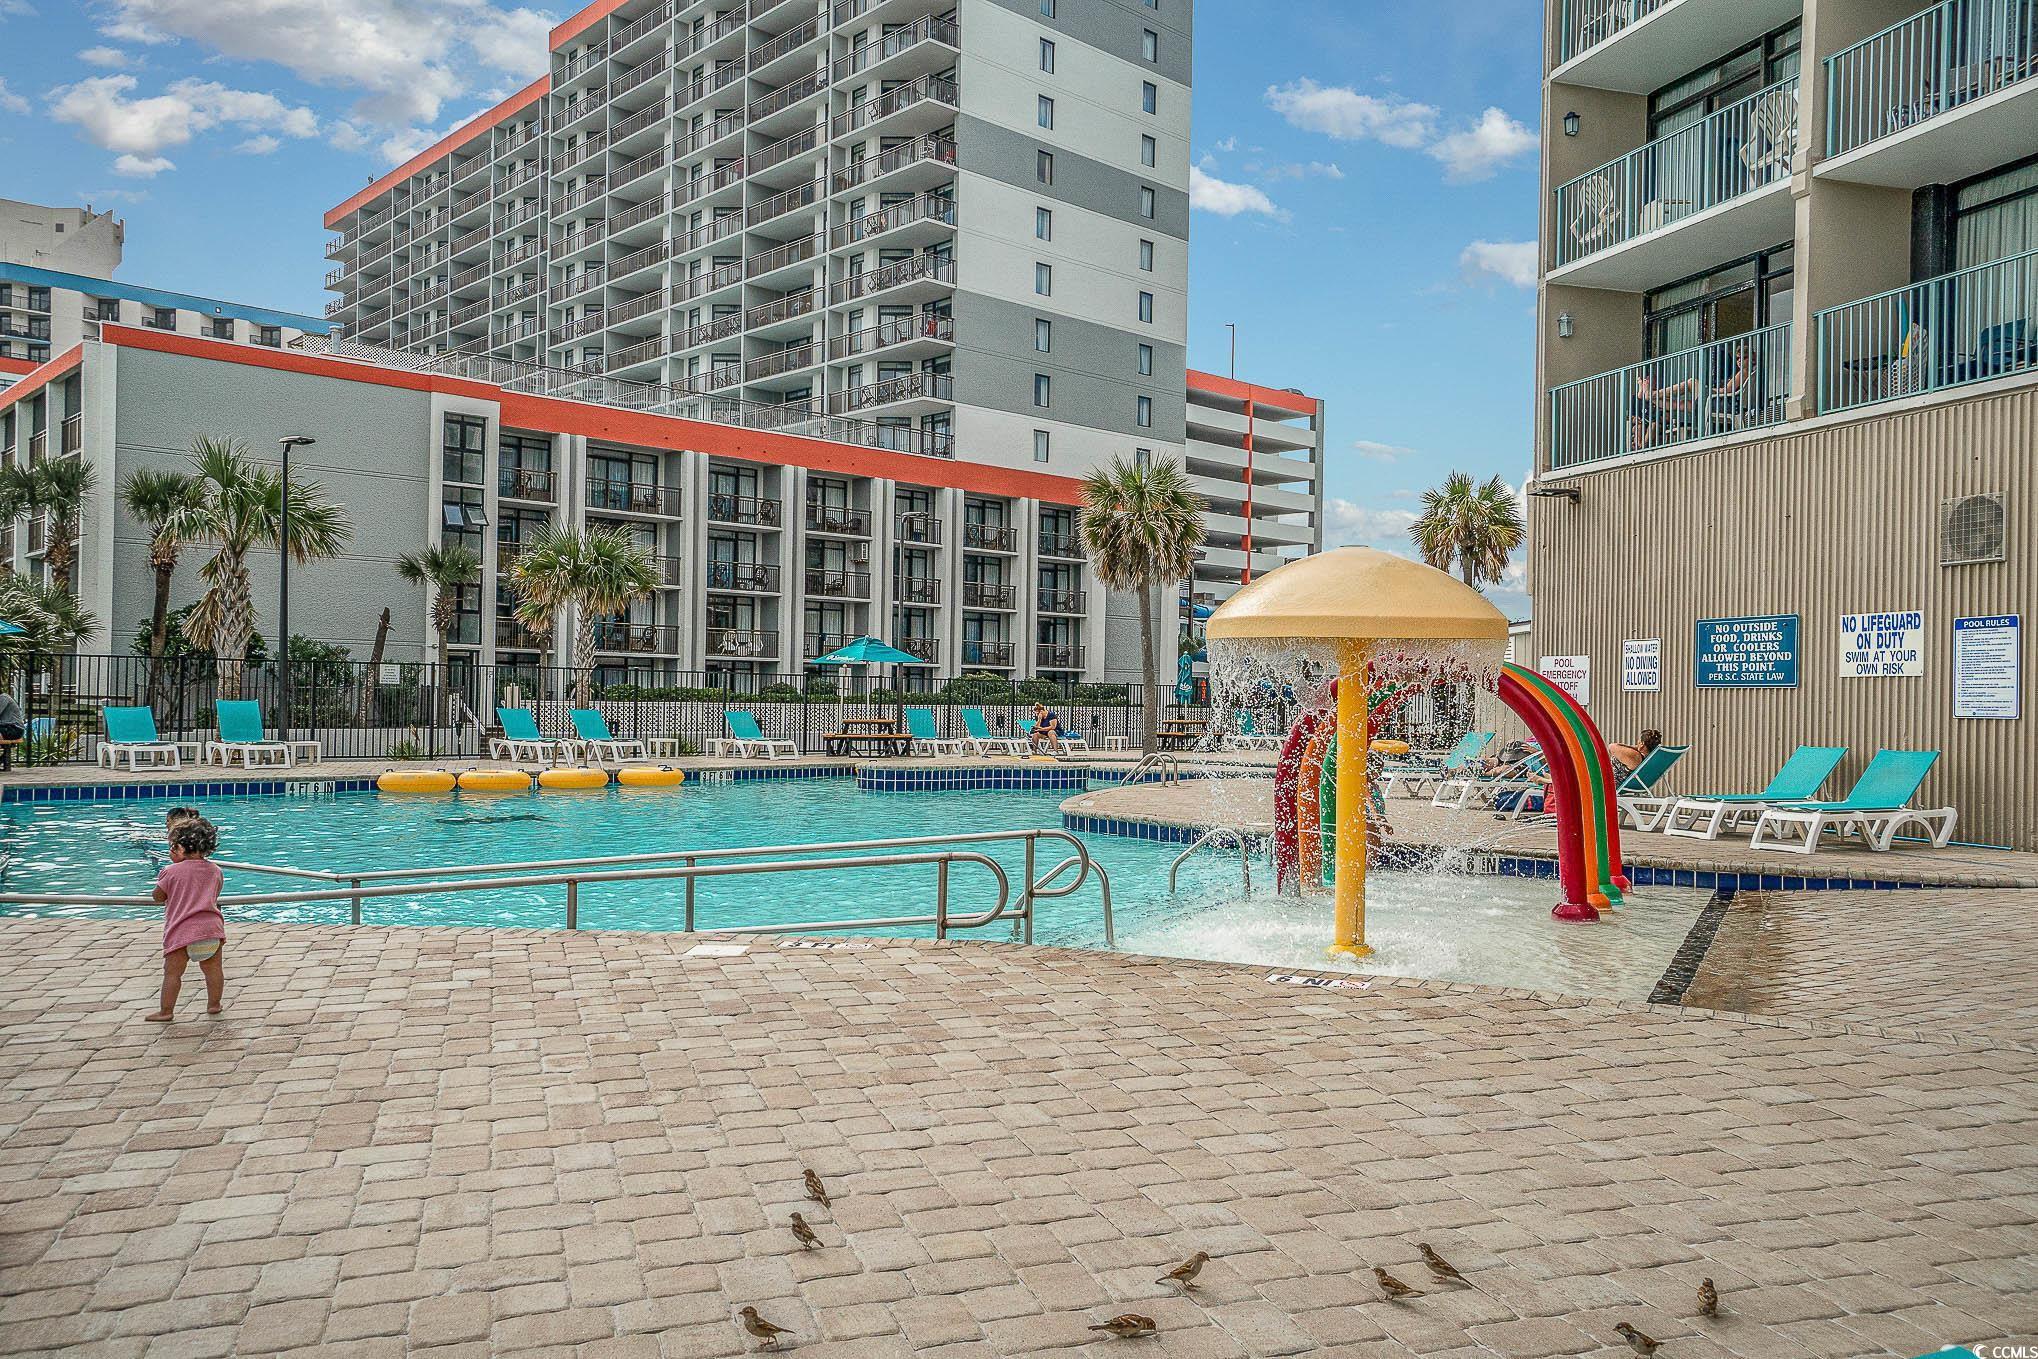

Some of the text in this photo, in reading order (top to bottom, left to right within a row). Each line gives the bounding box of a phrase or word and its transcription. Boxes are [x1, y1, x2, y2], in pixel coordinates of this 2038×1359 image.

[1715, 622, 1778, 633] NO OUTSIDE
[1842, 612, 1921, 633] NO LIFEGUARD
[1963, 618, 2010, 628] POOL RULES
[1710, 631, 1783, 643] FOOD, DRINKS
[1856, 631, 1905, 650] ON DUTY
[1713, 642, 1780, 653] OR COOLERS
[1701, 651, 1792, 663] ALLOWED BEYOND
[1845, 649, 1917, 663] SWIM AT YOUR
[1554, 658, 1575, 668] POOL
[1625, 655, 1658, 670] NO DIVING
[1715, 662, 1776, 672] THIS POINT.
[1856, 662, 1904, 675] OWN RISK
[1542, 669, 1587, 679] EMERGENCY
[1625, 671, 1657, 686] ALLOWED
[1708, 672, 1785, 681] PER S.C. STATE LAW
[1554, 681, 1579, 691] UTOFF
[726, 770, 732, 780] IN
[290, 782, 334, 794] 4 FT 6 IN
[1466, 856, 1496, 872] 6 IN
